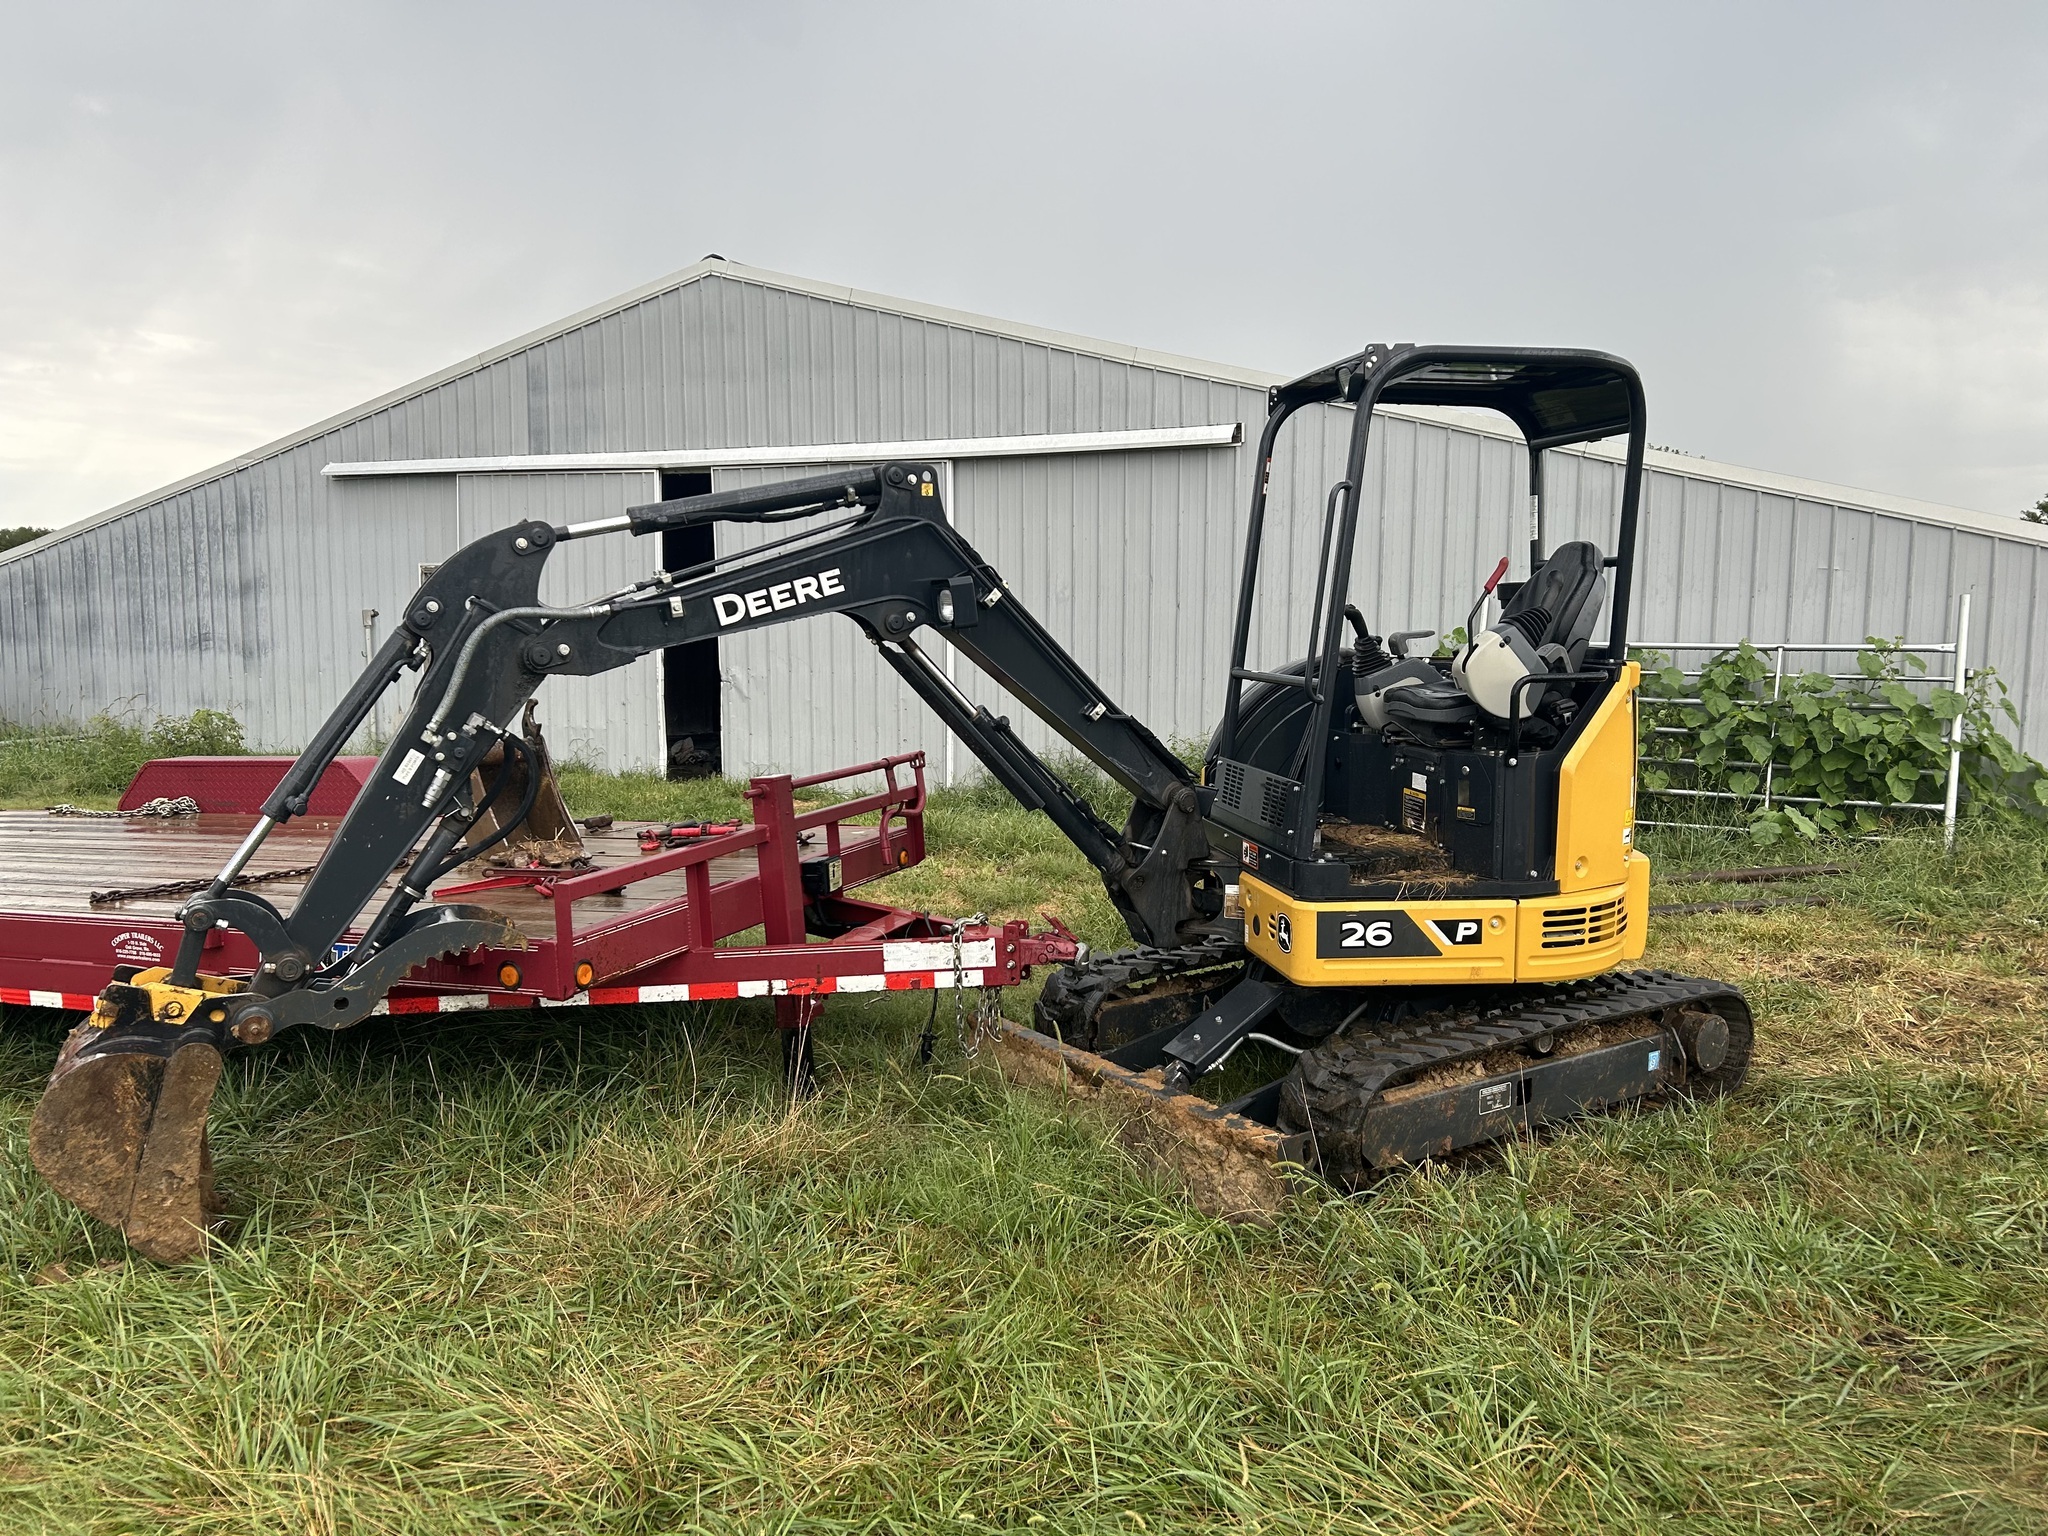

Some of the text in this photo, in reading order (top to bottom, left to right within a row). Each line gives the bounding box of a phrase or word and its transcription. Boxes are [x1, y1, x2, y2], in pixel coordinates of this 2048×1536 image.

[713, 568, 845, 626] DEERE
[111, 932, 165, 951] COOPER TRAILERS LLC
[1340, 921, 1393, 948] 26
[1455, 922, 1478, 942] P
